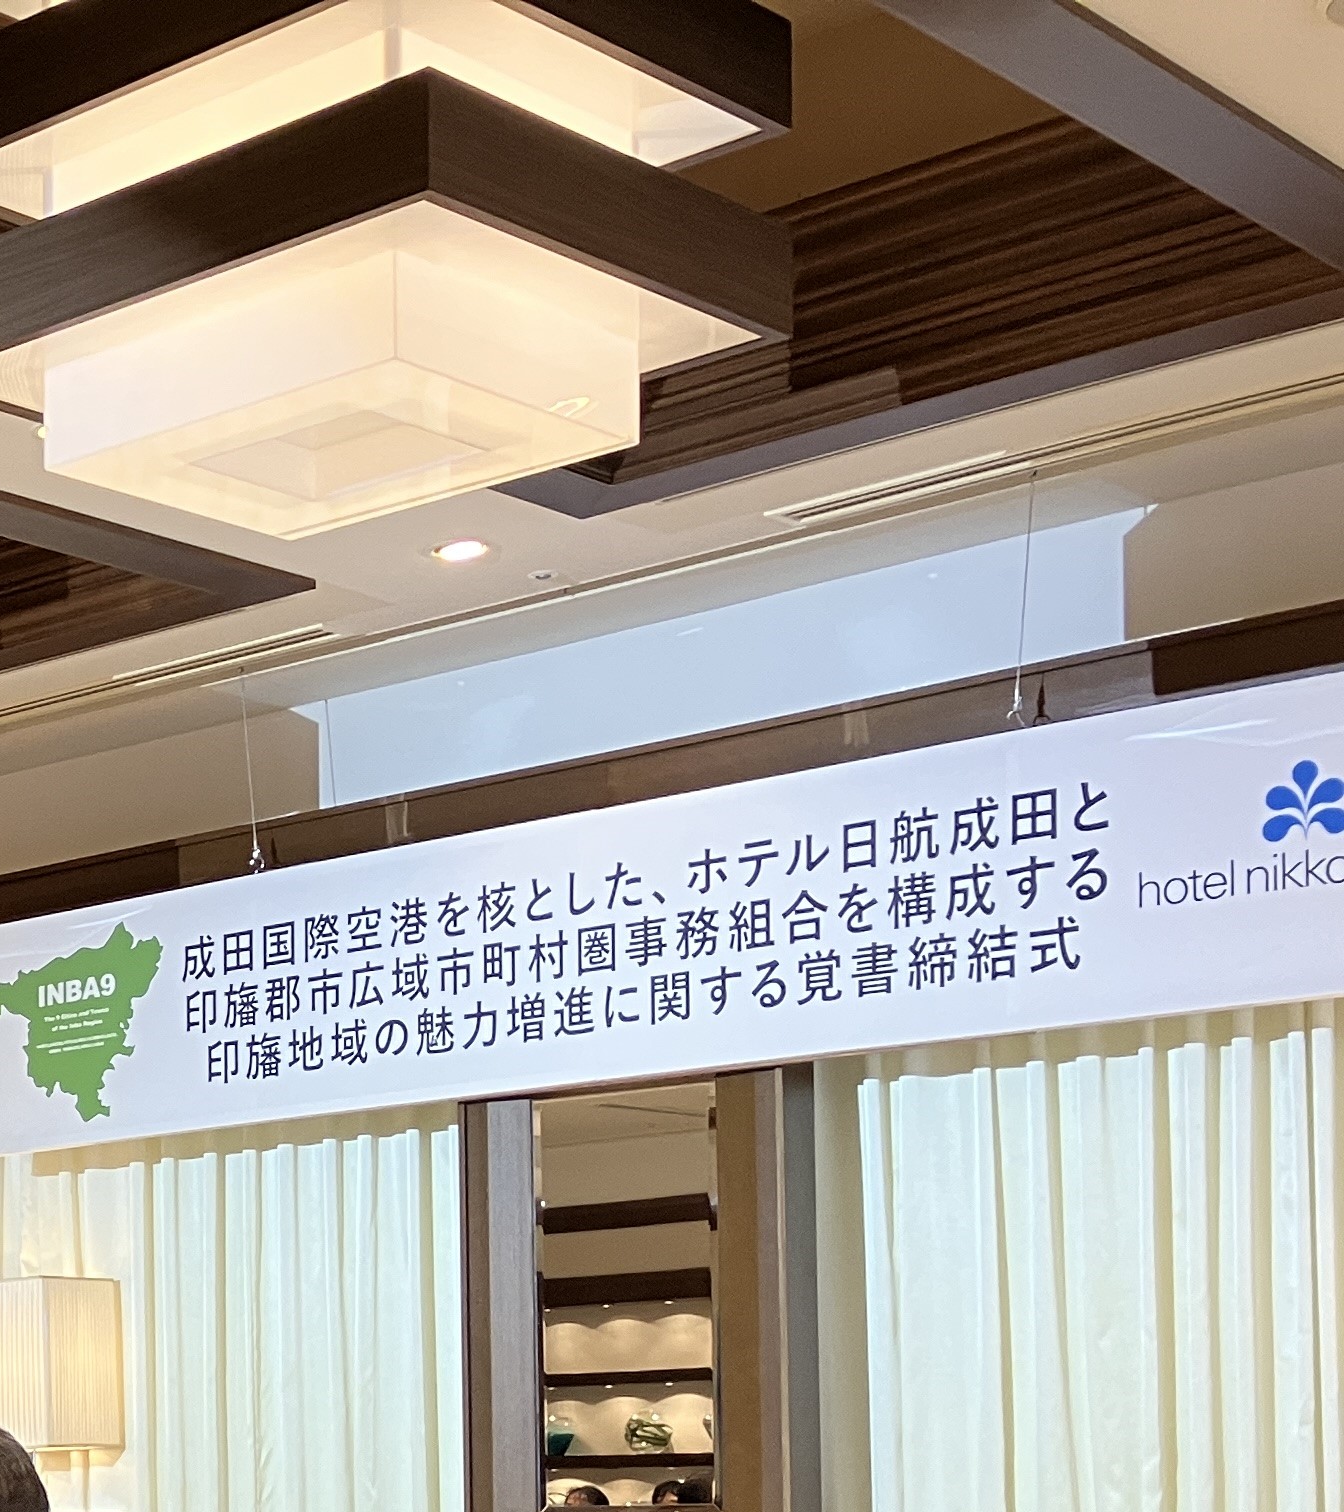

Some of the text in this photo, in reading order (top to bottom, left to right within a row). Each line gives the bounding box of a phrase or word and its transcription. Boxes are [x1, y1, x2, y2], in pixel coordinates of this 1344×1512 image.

[181, 782, 1109, 983] 成田国際空港を核とした、ホテル日航成田と
[185, 847, 1109, 1035] 印旛郡市広域市町村圏事務組合を構成する
[1138, 858, 1235, 909] hotel
[37, 972, 116, 1008] INBA9
[206, 916, 1081, 1085] 印旛地域の魅力増進に関する覚書締結式
